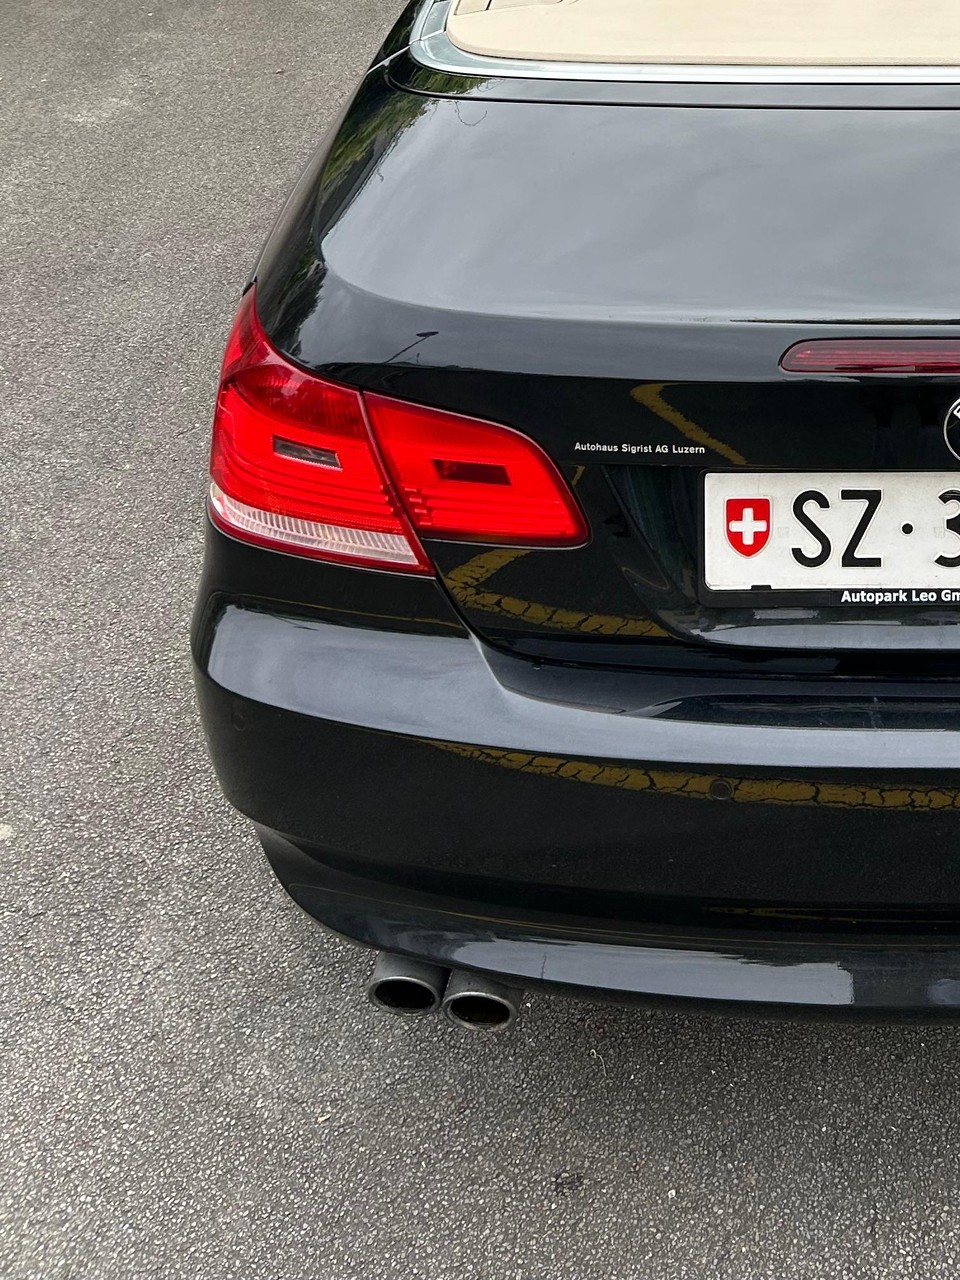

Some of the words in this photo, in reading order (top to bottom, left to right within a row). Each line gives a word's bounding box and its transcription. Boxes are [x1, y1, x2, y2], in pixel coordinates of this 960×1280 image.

[574, 442, 619, 452] Autohaus
[621, 443, 653, 454] Sigrist
[655, 444, 669, 454] AG
[672, 444, 706, 454] Luzern
[841, 590, 908, 604] Autopark
[911, 590, 938, 602] Leo
